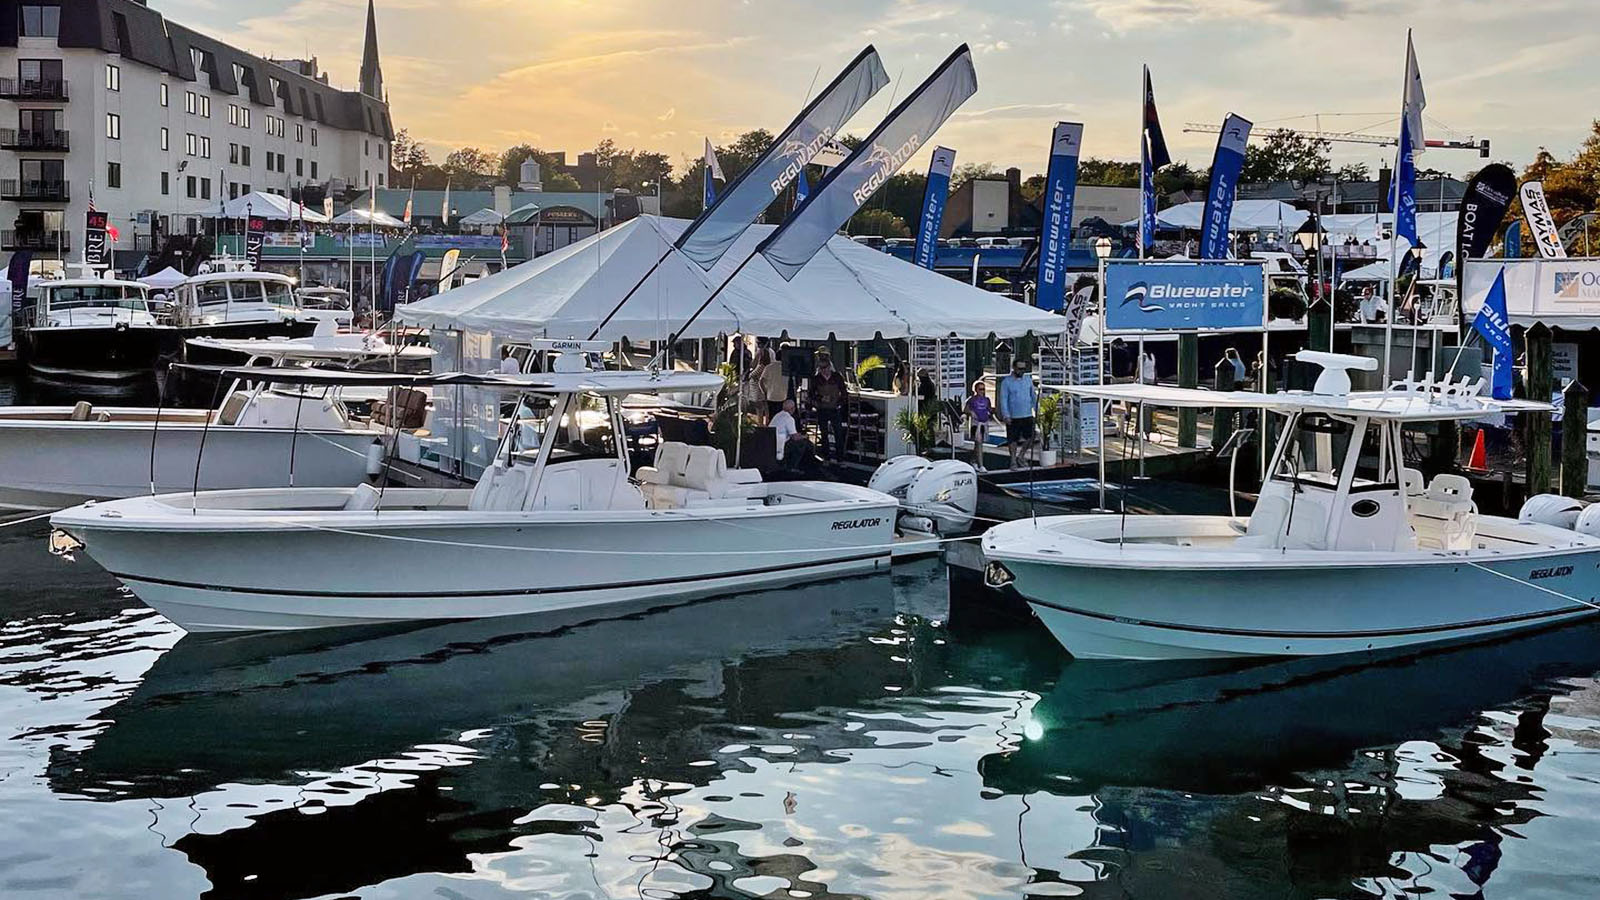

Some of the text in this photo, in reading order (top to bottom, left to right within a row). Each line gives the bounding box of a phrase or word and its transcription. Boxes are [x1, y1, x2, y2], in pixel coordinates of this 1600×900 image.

[771, 127, 833, 196] REGULATOR
[852, 134, 920, 206] REGULATOR
[1044, 179, 1065, 284] Bluewater
[1462, 203, 1478, 240] BOAT
[1525, 188, 1557, 257] CAYMAS
[1150, 283, 1254, 298] Bluewater
[551, 341, 582, 350] GARMIN
[831, 518, 881, 531] REGULATOR
[1529, 566, 1574, 580] REGULATOR
